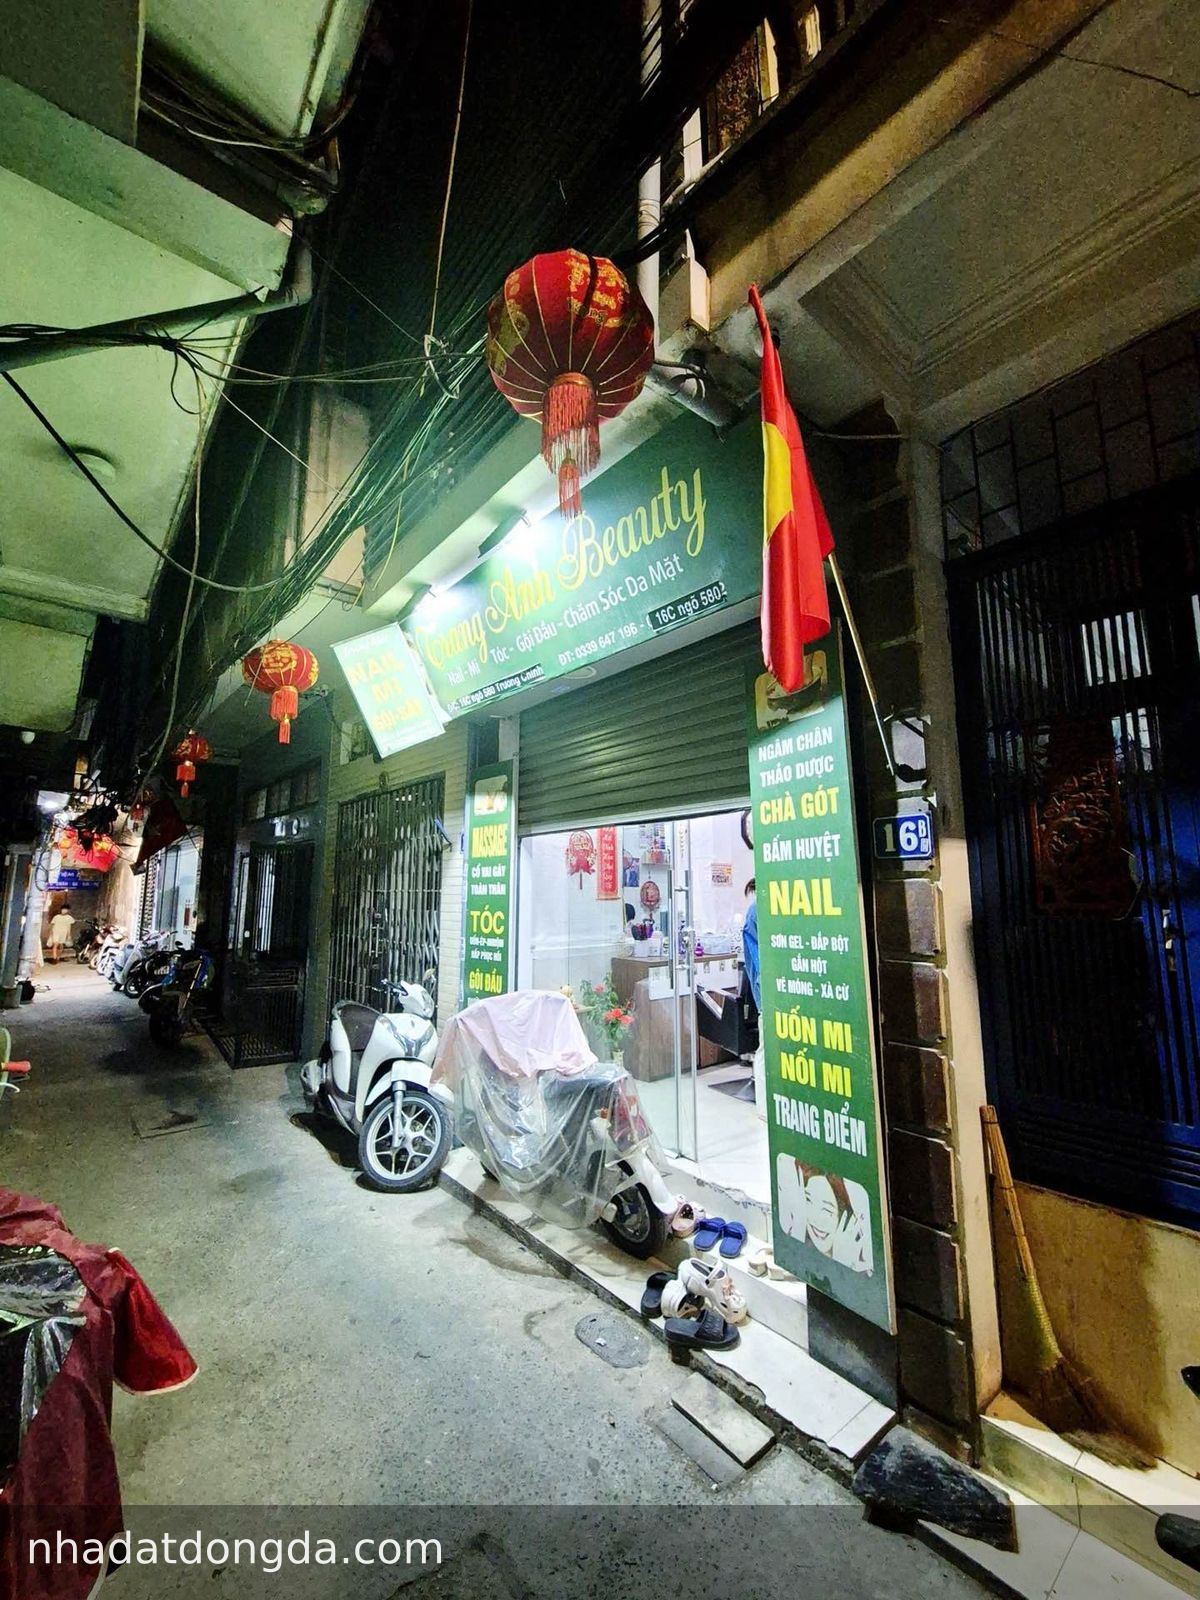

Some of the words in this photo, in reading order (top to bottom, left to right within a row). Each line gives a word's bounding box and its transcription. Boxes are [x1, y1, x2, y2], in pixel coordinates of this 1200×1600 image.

[555, 466, 707, 591] Beauty
[490, 646, 510, 664] Tóc
[563, 602, 601, 629] Chăm
[599, 586, 627, 612] Sóc
[625, 575, 649, 597] Da
[648, 553, 684, 587] Mặt
[655, 605, 677, 626] 16C
[677, 594, 700, 617] ngõ
[700, 585, 721, 607] 580
[558, 652, 576, 666] ĐT:
[598, 632, 616, 649] 647
[619, 622, 638, 640] 196
[758, 738, 793, 762] NGÂM
[796, 726, 833, 752] CHÂN
[795, 755, 834, 780] DƯỢC
[760, 790, 796, 826] CHÀ
[800, 784, 840, 819] GÓT
[471, 823, 508, 858] MASSAGE
[762, 834, 793, 864] BẤM
[795, 831, 841, 863] HUYỆT
[768, 878, 842, 917] NAIL
[470, 904, 505, 935] TÓC
[788, 935, 804, 950] GEL
[831, 934, 849, 955] BỘT
[810, 956, 828, 977] HỘT
[787, 978, 814, 997] MÓNG
[820, 981, 834, 999] XÀ
[775, 1005, 817, 1046] UỐN
[822, 1020, 853, 1054] MI
[780, 1048, 816, 1088] NỐI
[822, 1065, 853, 1098] MI
[773, 1093, 820, 1140] TRANG
[823, 1101, 868, 1157] ĐIỂM
